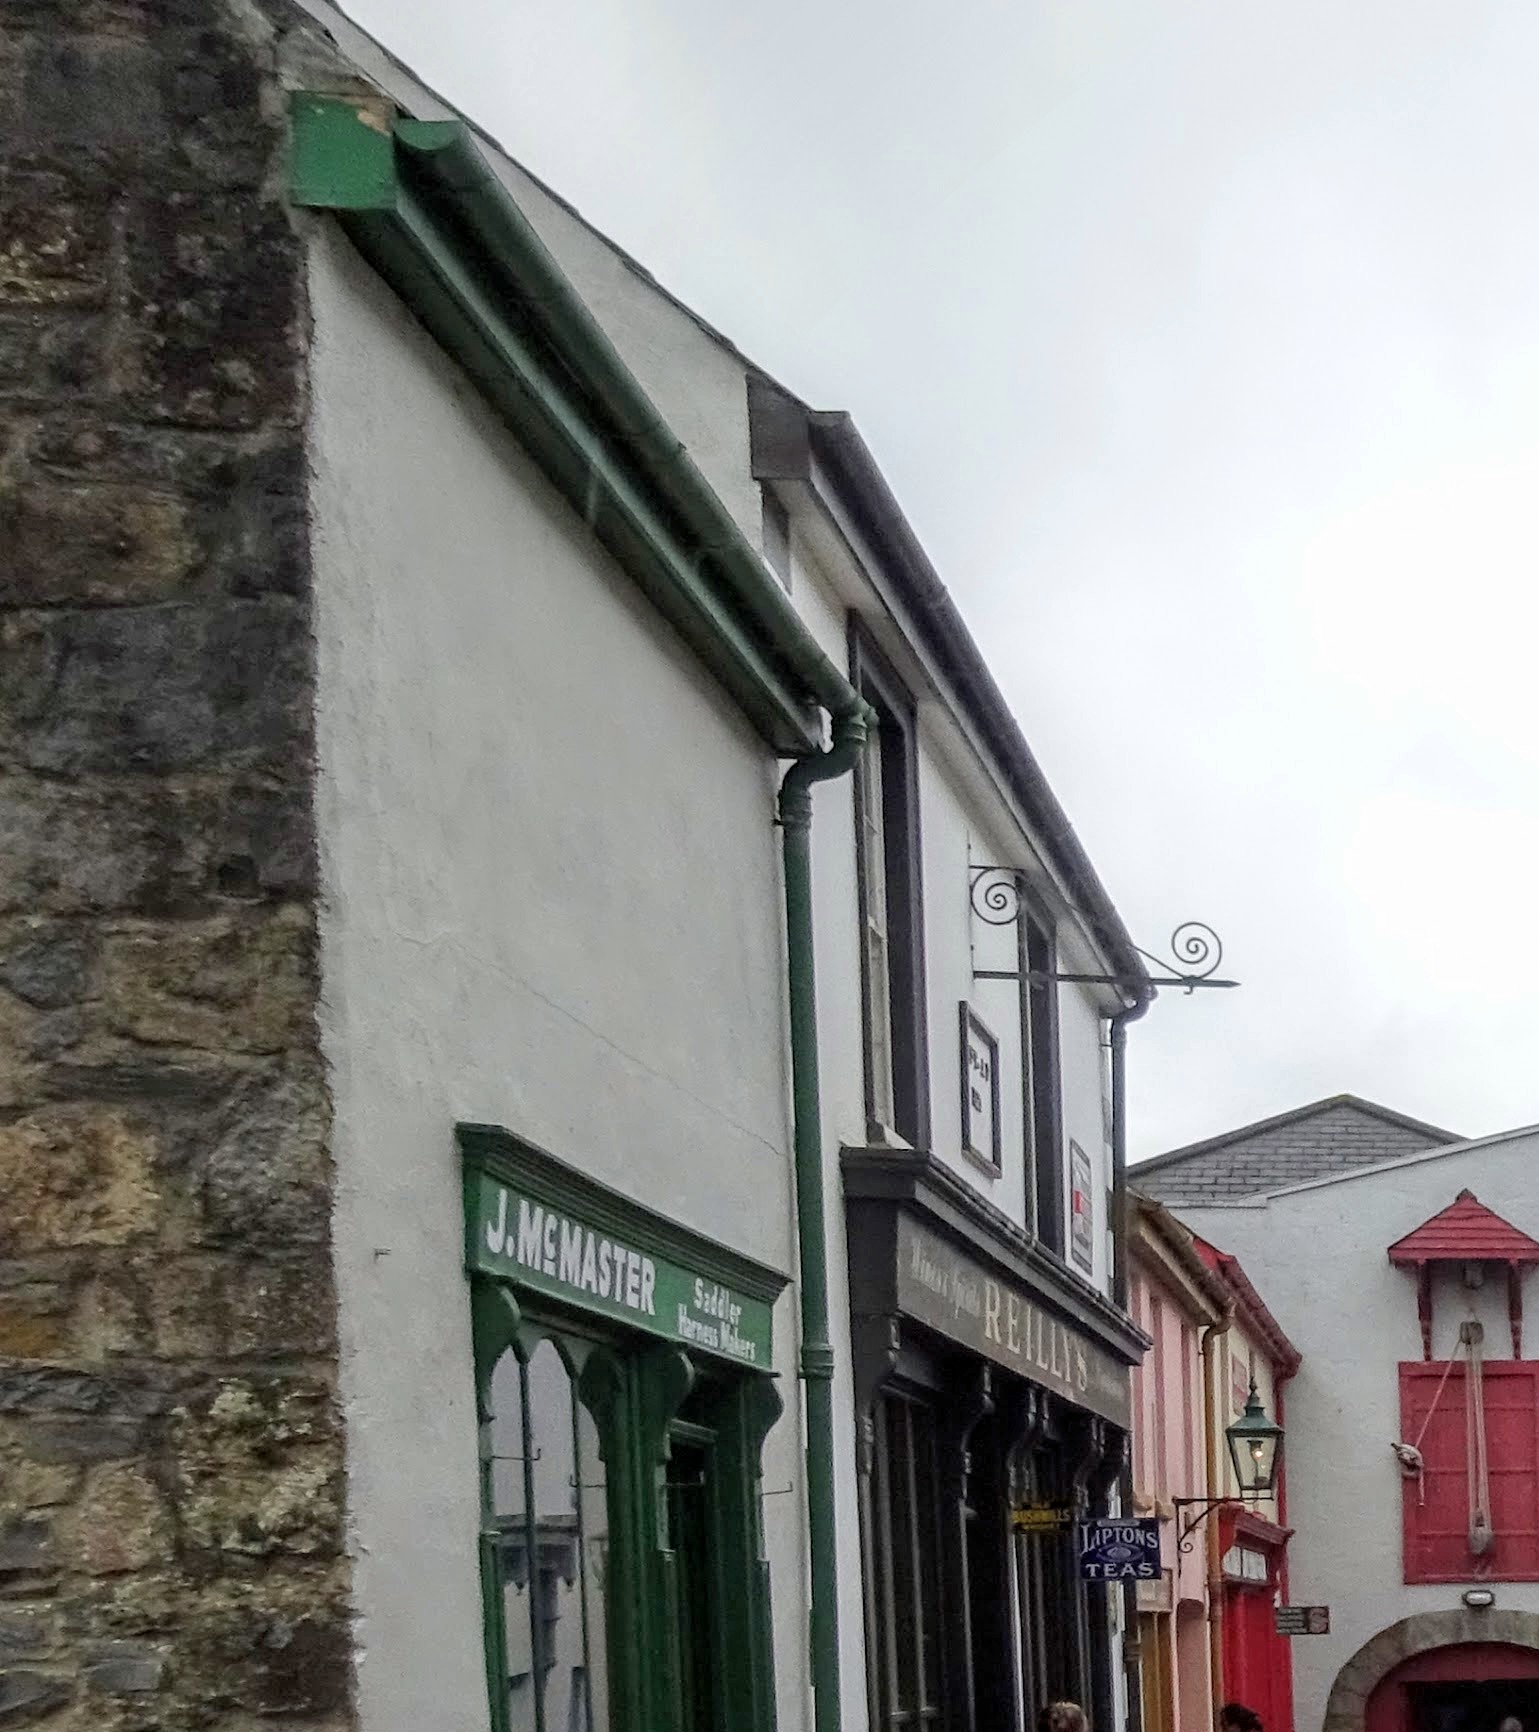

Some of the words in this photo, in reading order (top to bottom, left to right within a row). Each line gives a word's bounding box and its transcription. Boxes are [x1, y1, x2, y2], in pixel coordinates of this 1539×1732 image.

[694, 1277, 742, 1325] Saddler
[1081, 1524, 1158, 1556] LIPTONS
[1085, 1562, 1154, 1577] TEAS
